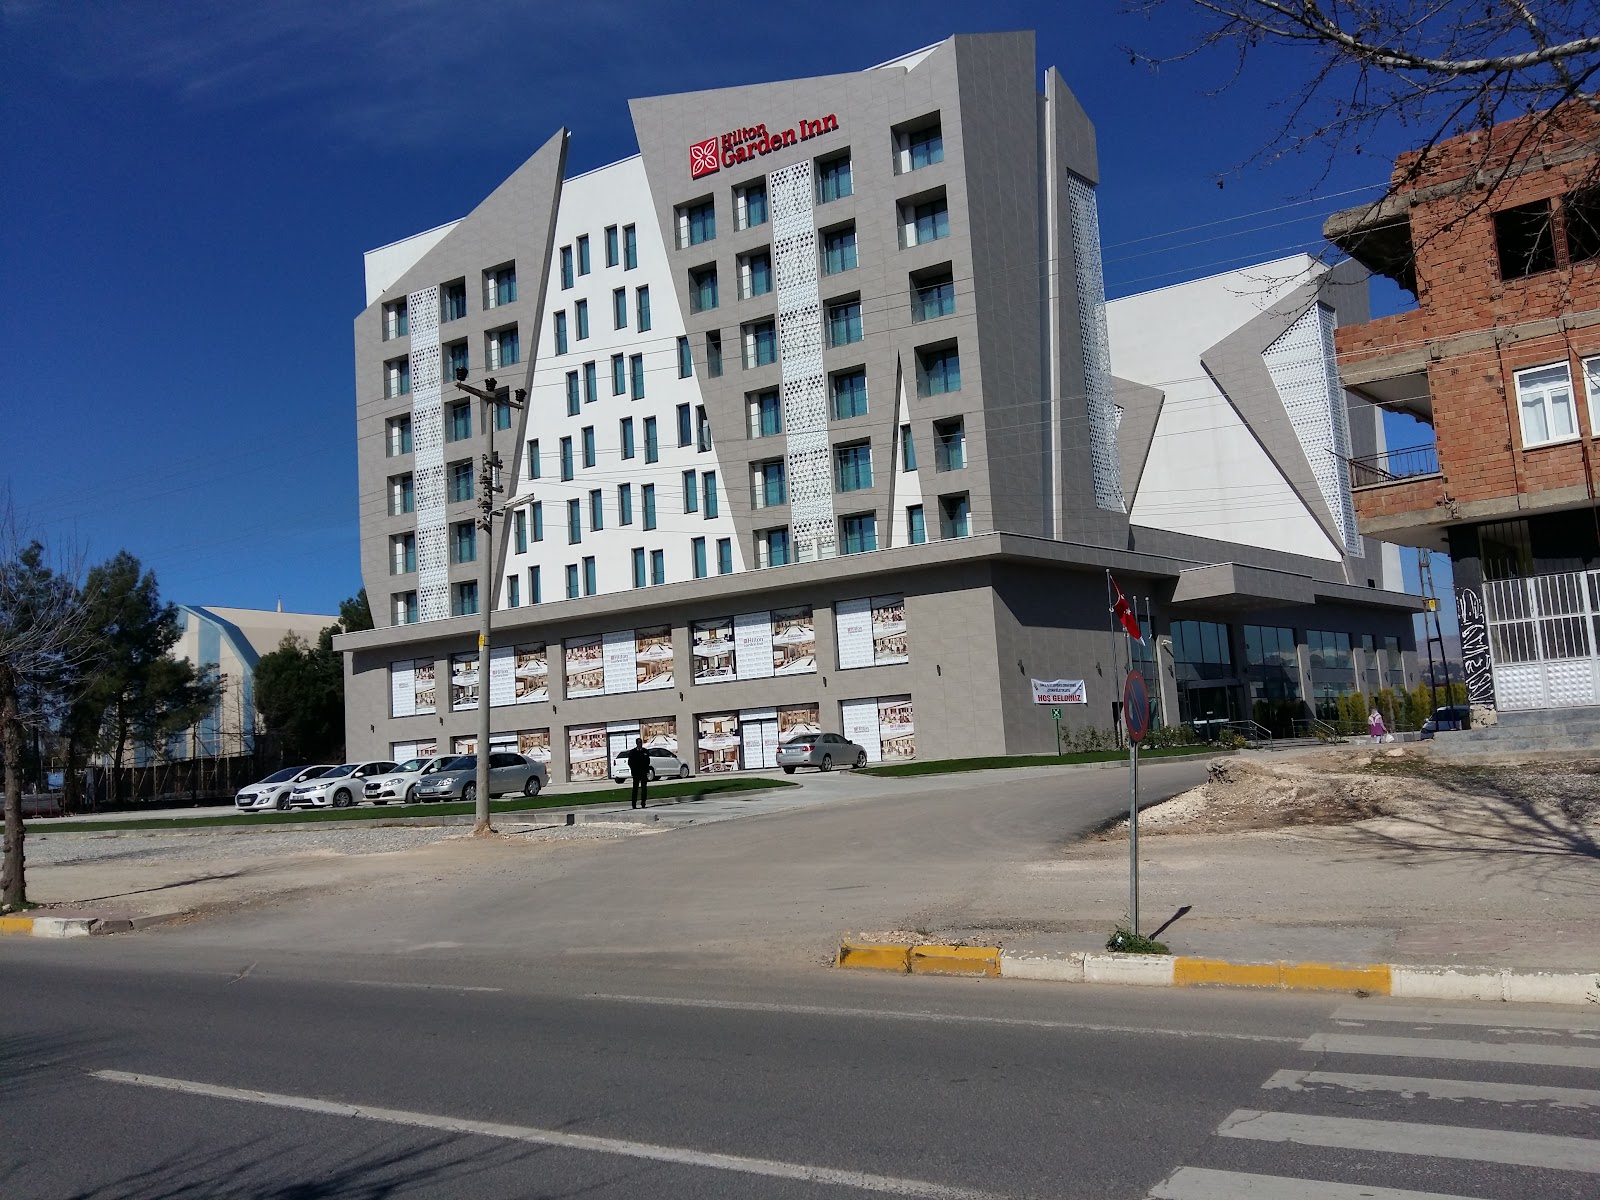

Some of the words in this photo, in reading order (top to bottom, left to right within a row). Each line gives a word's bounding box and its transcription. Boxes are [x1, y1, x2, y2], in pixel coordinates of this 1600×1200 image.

[720, 123, 767, 148] Hilton
[721, 128, 798, 169] Garden
[799, 113, 840, 142] Inn
